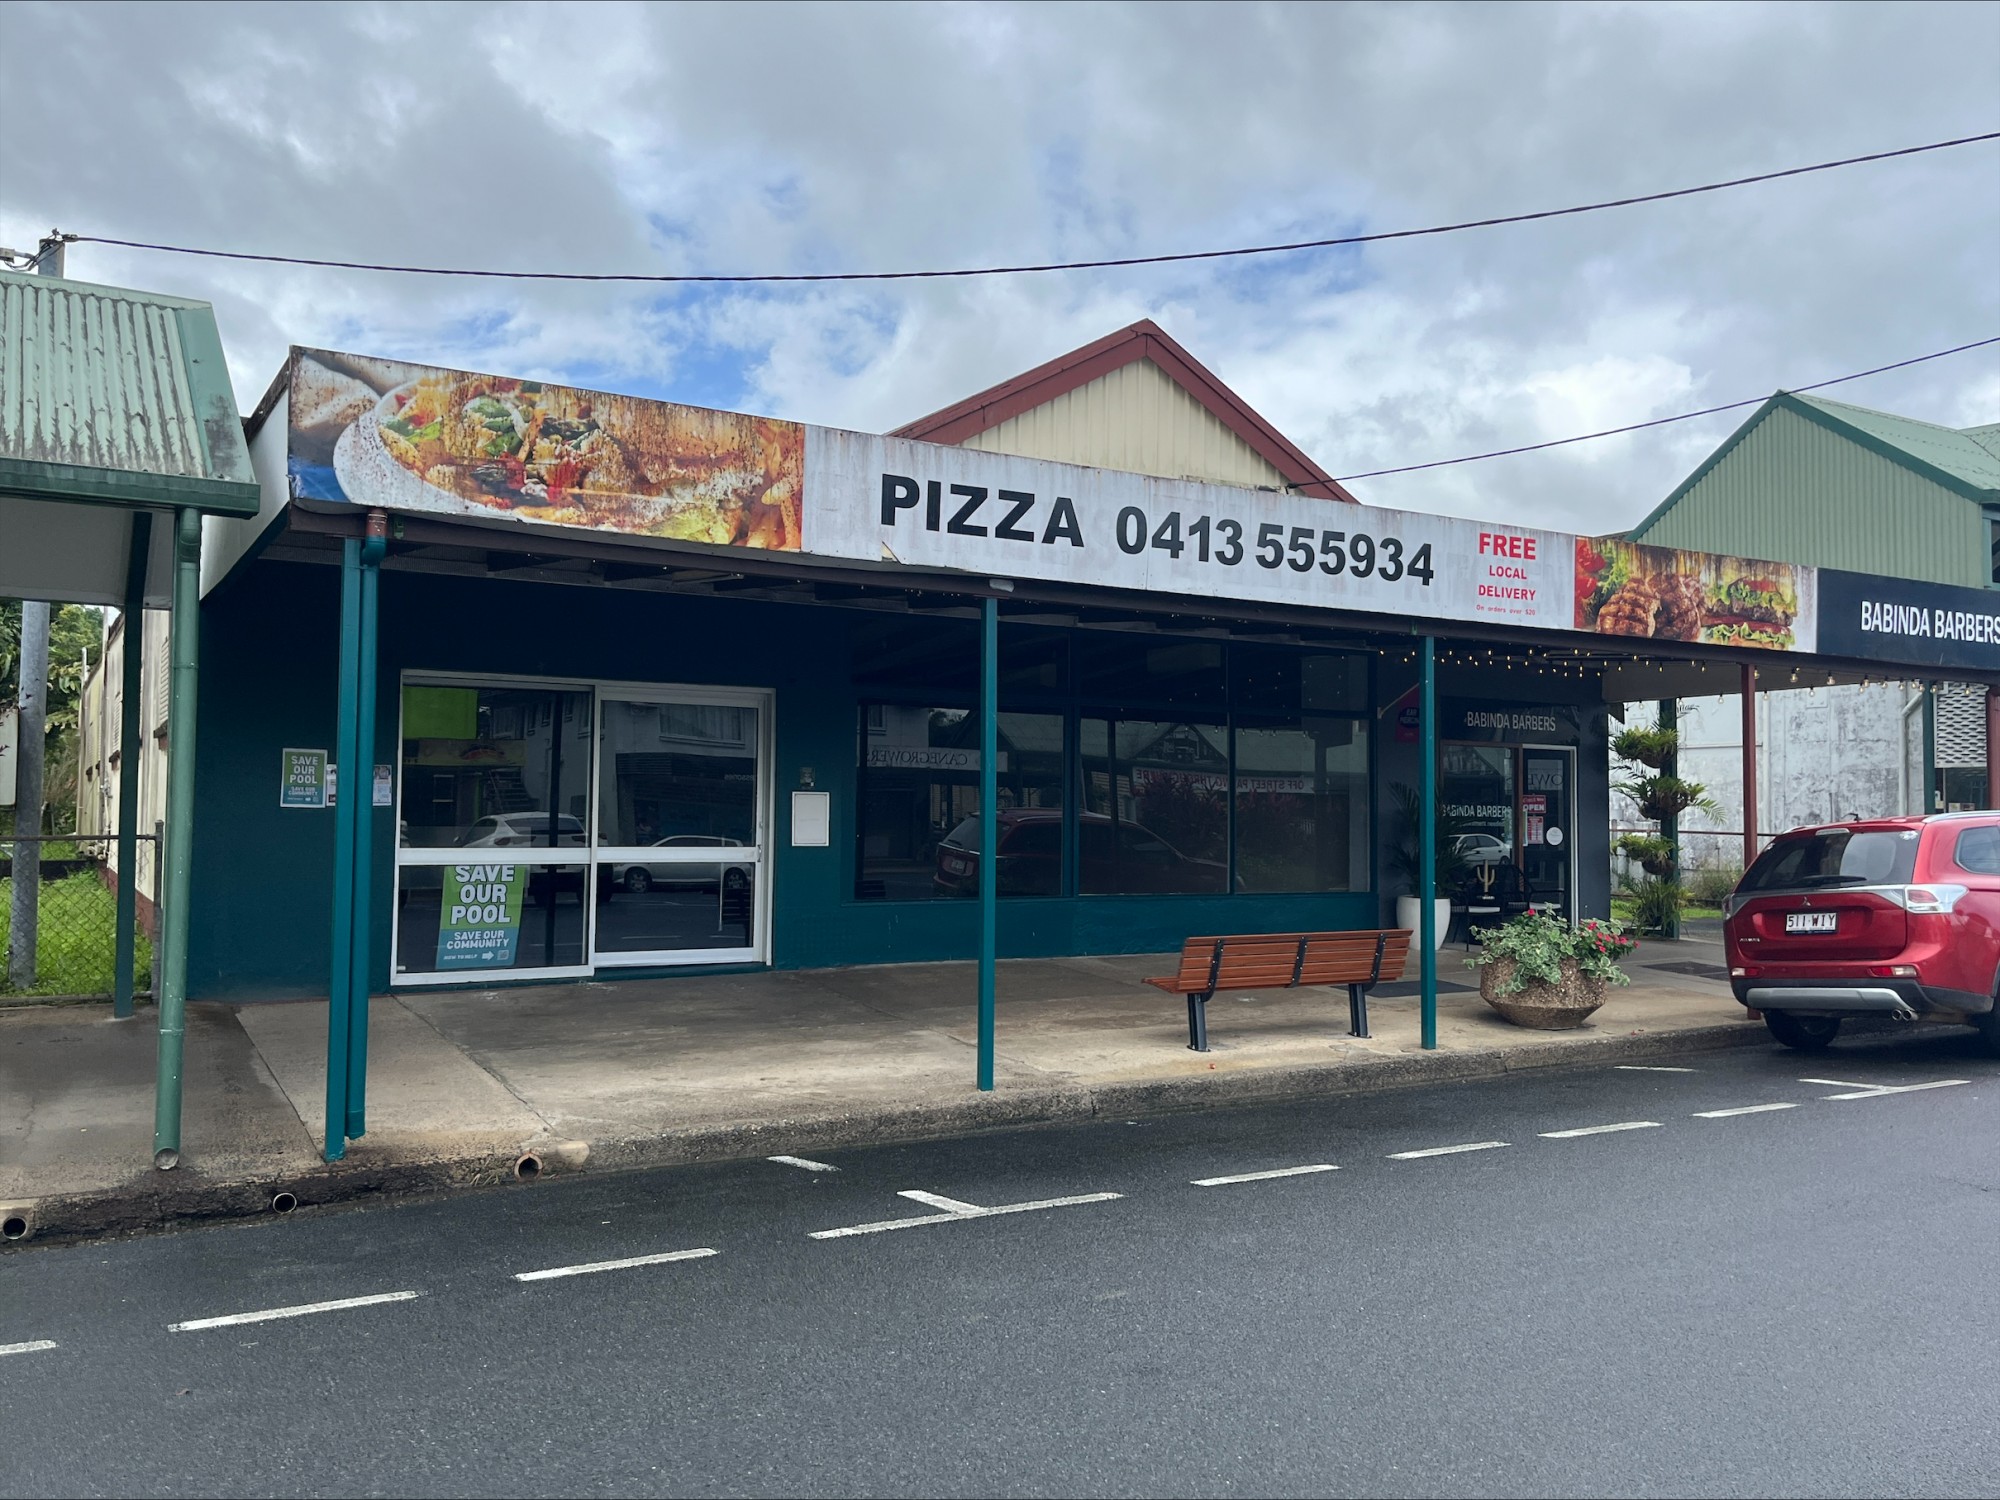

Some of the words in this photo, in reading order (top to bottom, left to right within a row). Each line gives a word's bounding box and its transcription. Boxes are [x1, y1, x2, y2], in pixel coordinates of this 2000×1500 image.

[881, 473, 1085, 548] PIZZA
[1116, 506, 1244, 566] 0413
[1255, 523, 1434, 586] 555934
[1478, 532, 1537, 560] FREE
[1489, 565, 1528, 580] LOCAL
[1478, 584, 1536, 601] DELIVERY
[1861, 600, 1931, 637] BABINDA
[1934, 609, 2000, 644] BARBERS
[1467, 711, 1510, 729] BABINDA
[1512, 714, 1556, 731] BARBERS
[291, 755, 319, 765] SAVE
[293, 766, 315, 775] OUR
[289, 775, 318, 784] POOL
[1476, 805, 1512, 818] BARBERS
[1522, 804, 1545, 812] OPEN
[455, 865, 515, 883] SAVE
[460, 884, 507, 904] OUR
[450, 904, 511, 925] POOL
[454, 931, 482, 940] SAVE
[483, 930, 505, 938] OUR
[446, 938, 510, 950] COMMUNITY
